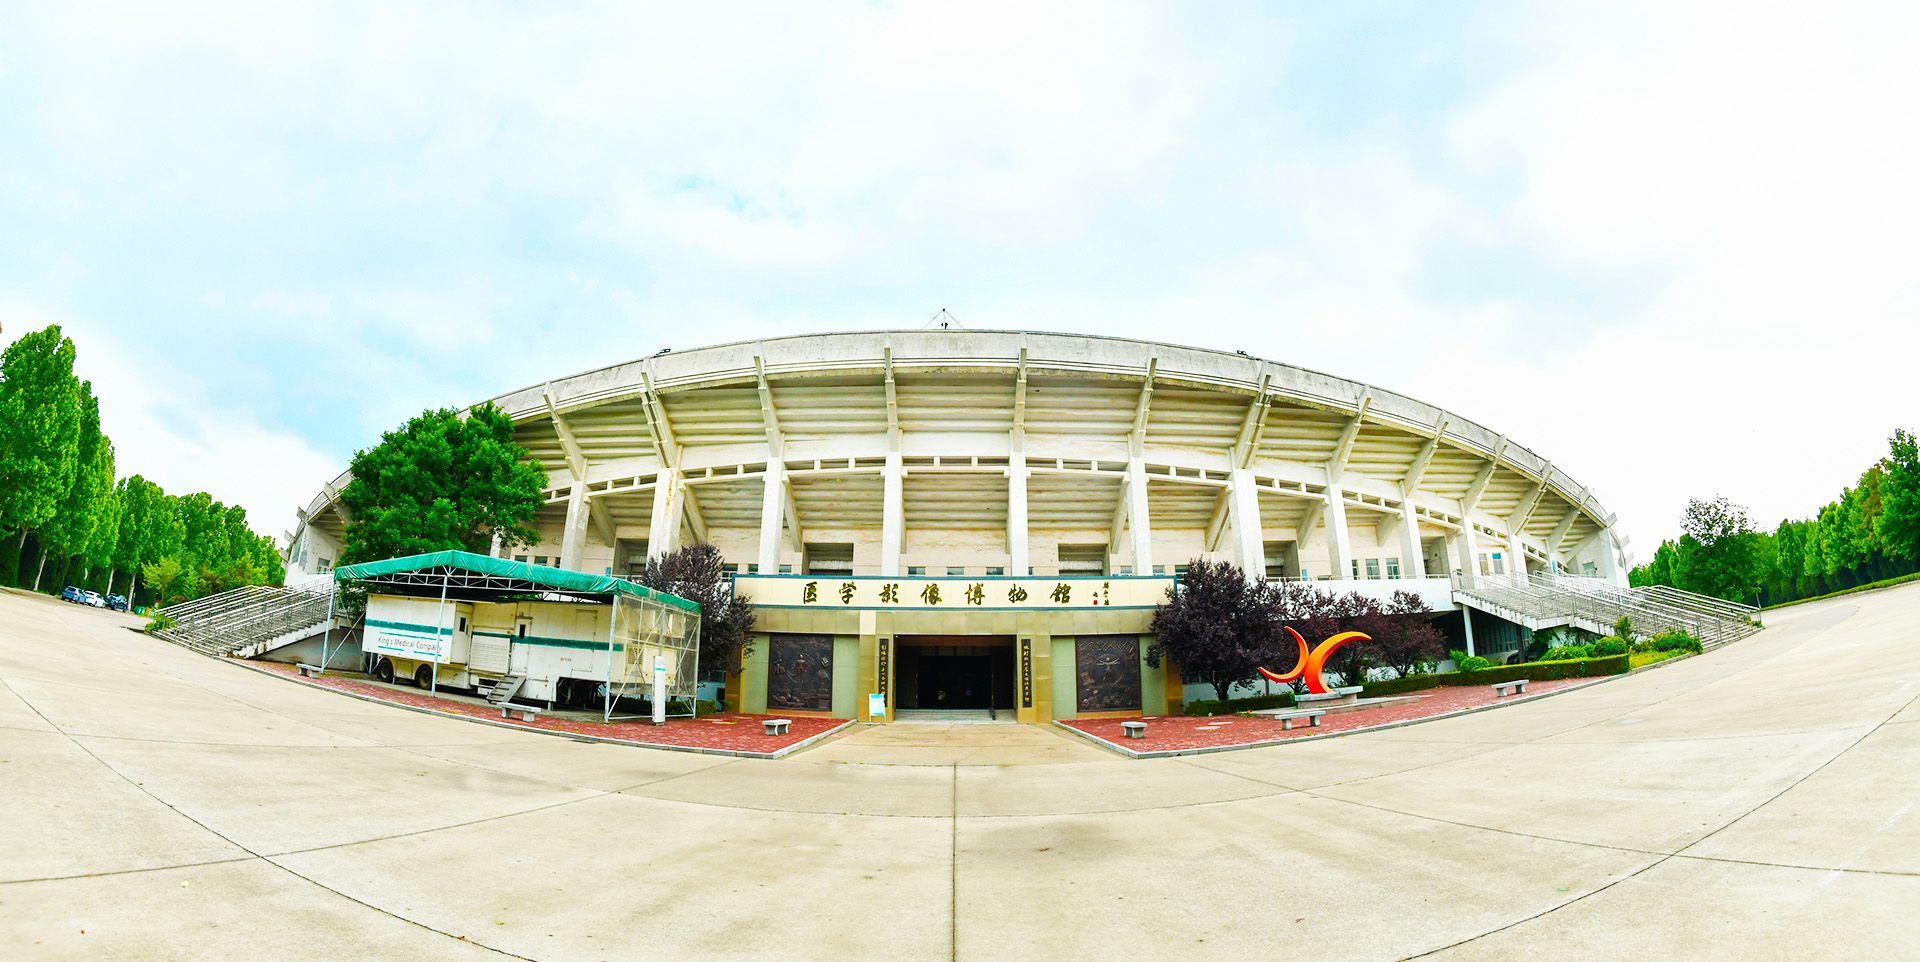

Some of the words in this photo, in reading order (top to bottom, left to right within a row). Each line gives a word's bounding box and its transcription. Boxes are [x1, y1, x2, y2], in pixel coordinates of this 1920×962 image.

[377, 637, 393, 647] King's
[394, 638, 414, 648] Medical
[415, 641, 443, 653] Compay
